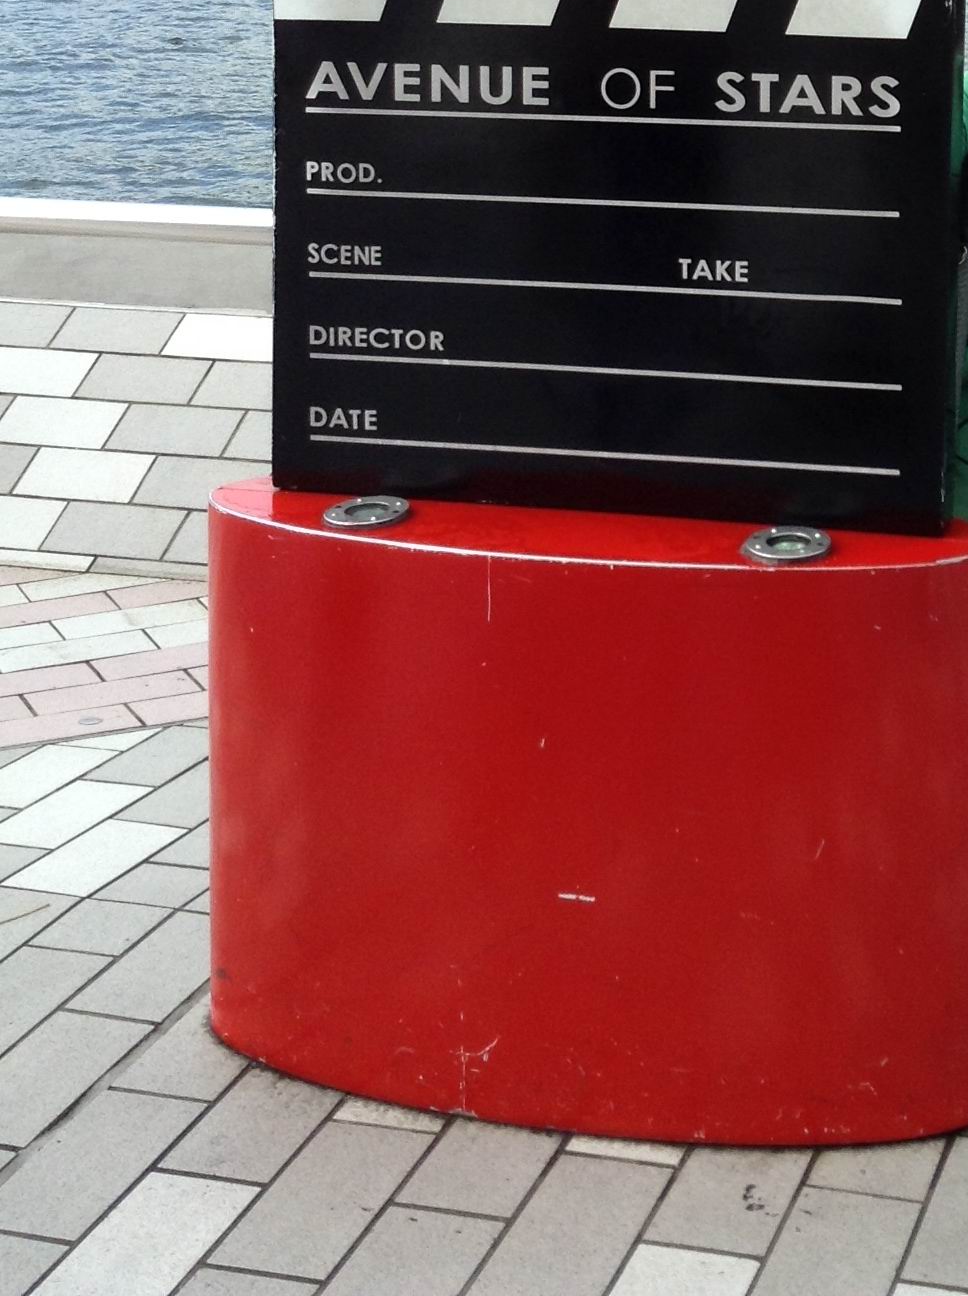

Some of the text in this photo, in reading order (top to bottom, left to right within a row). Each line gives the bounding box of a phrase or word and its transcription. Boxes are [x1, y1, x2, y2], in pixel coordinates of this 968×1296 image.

[306, 60, 901, 118] AVENUE OF STARS
[306, 160, 382, 185] PROD.
[307, 242, 382, 267] SCENE
[678, 258, 749, 283] TAKE
[309, 325, 444, 352] DIRECTOR
[309, 406, 378, 431] DATE
